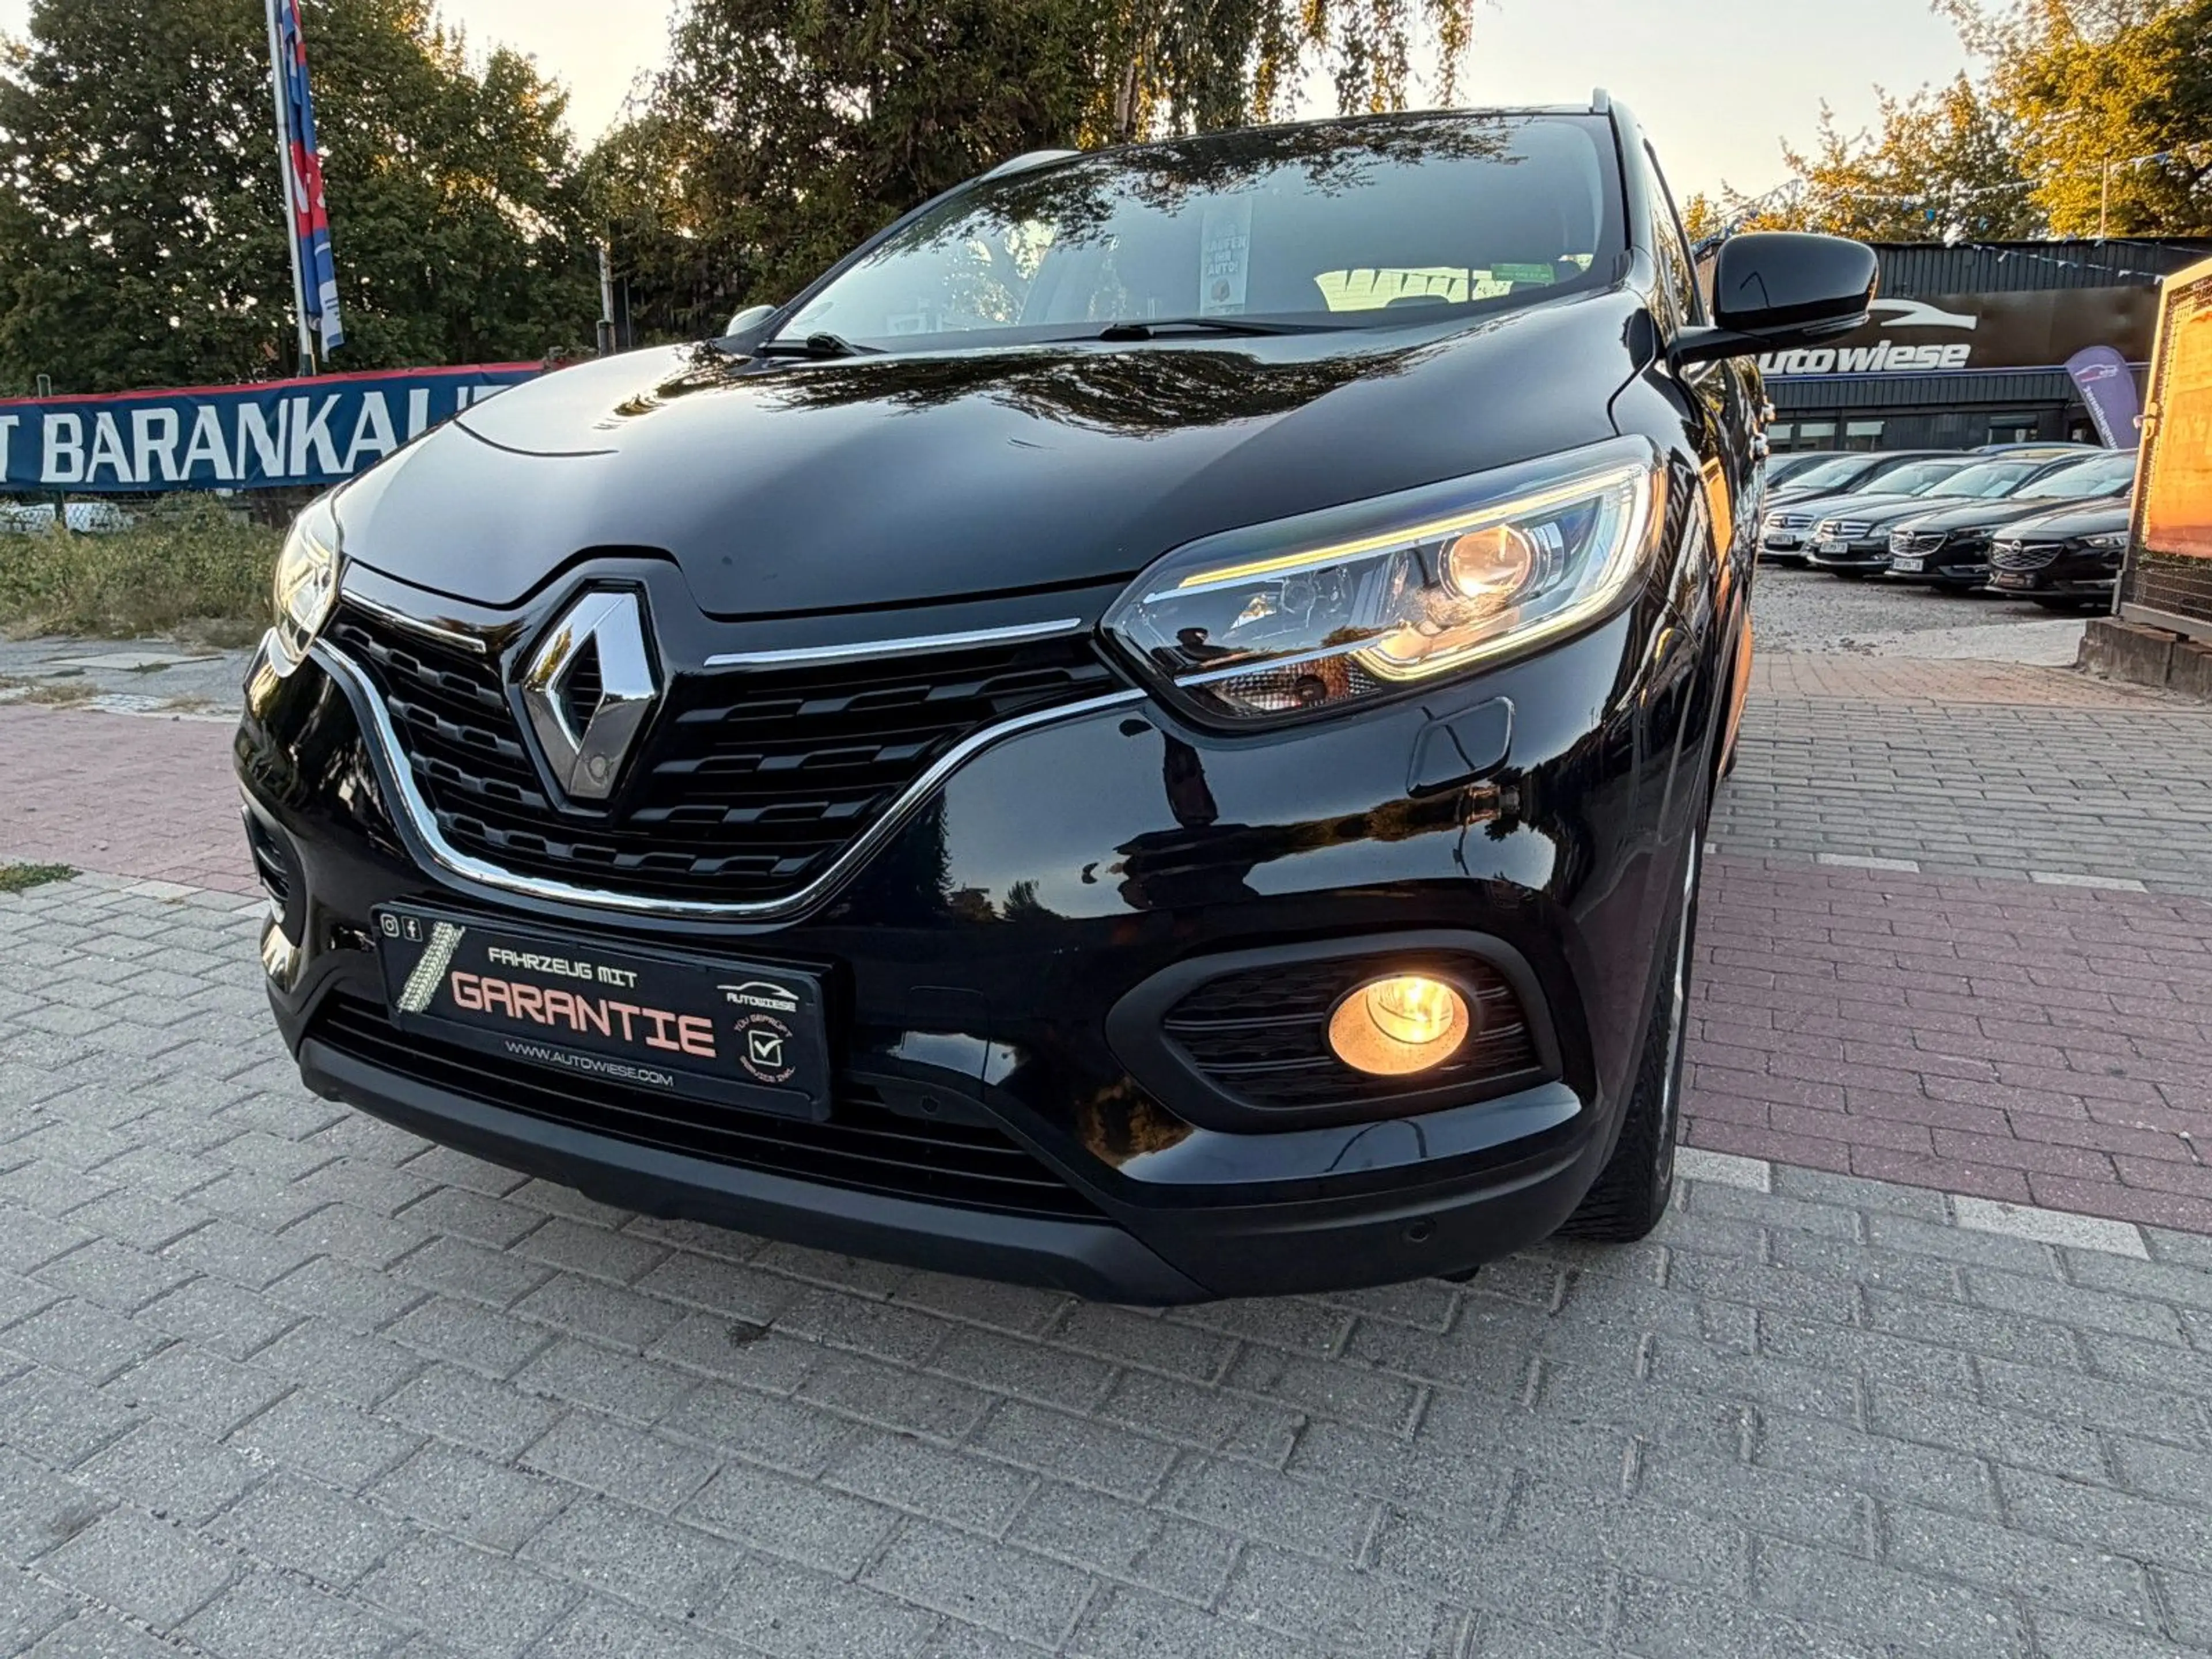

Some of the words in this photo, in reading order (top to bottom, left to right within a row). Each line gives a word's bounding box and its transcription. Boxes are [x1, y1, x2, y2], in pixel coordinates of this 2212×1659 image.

[40, 384, 516, 483] BARANKA
[488, 947, 592, 979] FAHRZEUG
[598, 965, 638, 988] MIT
[451, 970, 716, 1058] GARANTIE
[504, 1040, 675, 1087] WWW.AUTOWIESE.COM
